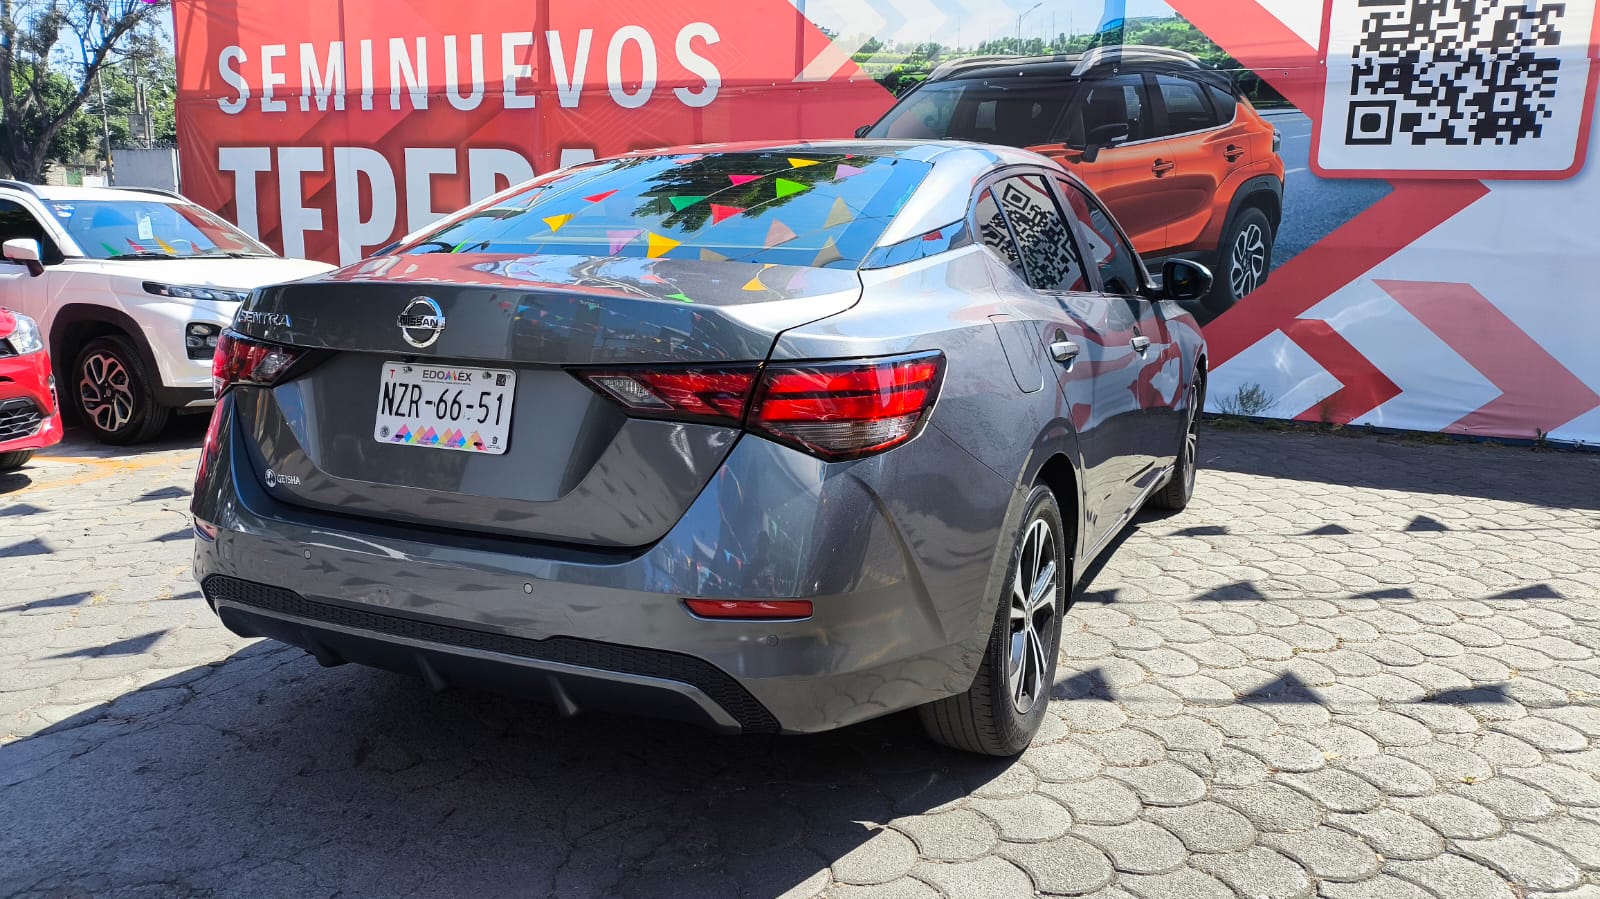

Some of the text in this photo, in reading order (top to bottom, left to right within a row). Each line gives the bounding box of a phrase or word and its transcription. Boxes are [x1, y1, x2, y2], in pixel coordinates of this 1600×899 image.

[217, 22, 722, 115] SEMINUEVOS
[239, 310, 291, 327] SENTRA
[400, 315, 439, 327] NISSAN
[381, 381, 503, 426] NZR-66-51
[276, 474, 301, 485] GEISHA
